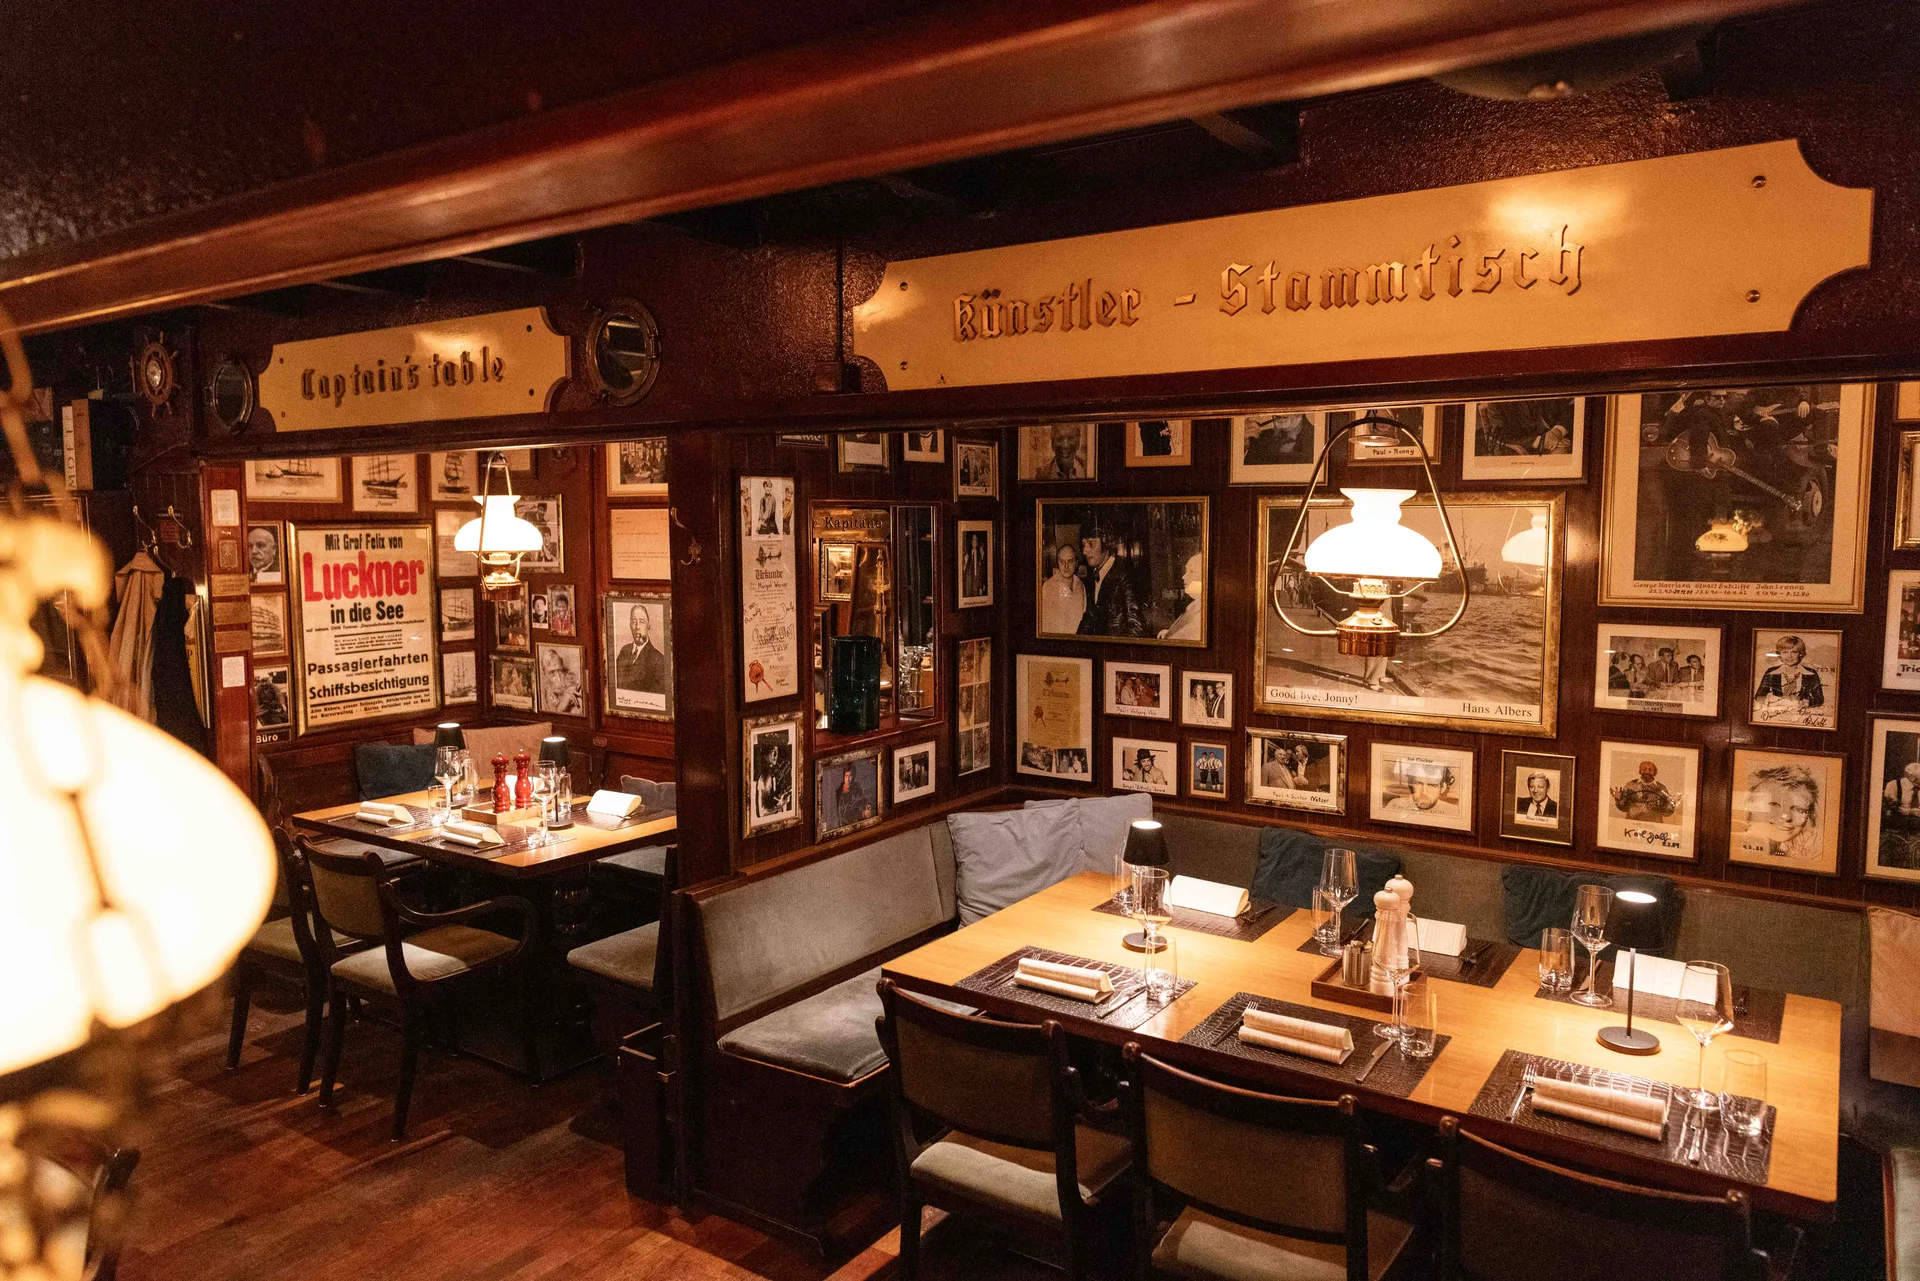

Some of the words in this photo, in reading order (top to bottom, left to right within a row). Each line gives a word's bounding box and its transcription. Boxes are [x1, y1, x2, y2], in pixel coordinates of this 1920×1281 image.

[952, 277, 1142, 344] Künstler
[1219, 224, 1586, 317] Stammtisch
[301, 354, 420, 408] Captain's
[428, 345, 505, 388] table
[824, 515, 884, 532] Kapitäne
[324, 533, 341, 551] Mit
[343, 533, 363, 550] Graf
[365, 532, 386, 550] Felix
[388, 535, 403, 549] von
[302, 550, 425, 602] Luckner
[1633, 581, 1657, 590] George
[1658, 581, 1691, 589] Harrison
[330, 603, 346, 624] in
[349, 602, 372, 622] die
[375, 600, 404, 621] See
[307, 653, 429, 676] Passagierfahrten
[309, 674, 430, 700] Schiffsbesichtigung
[1270, 688, 1296, 699] Good
[1300, 691, 1321, 702] bye,
[1324, 692, 1359, 705] Jonny!
[1462, 702, 1490, 714] Hans
[1494, 705, 1532, 717] Albers
[255, 733, 279, 744] Büro
